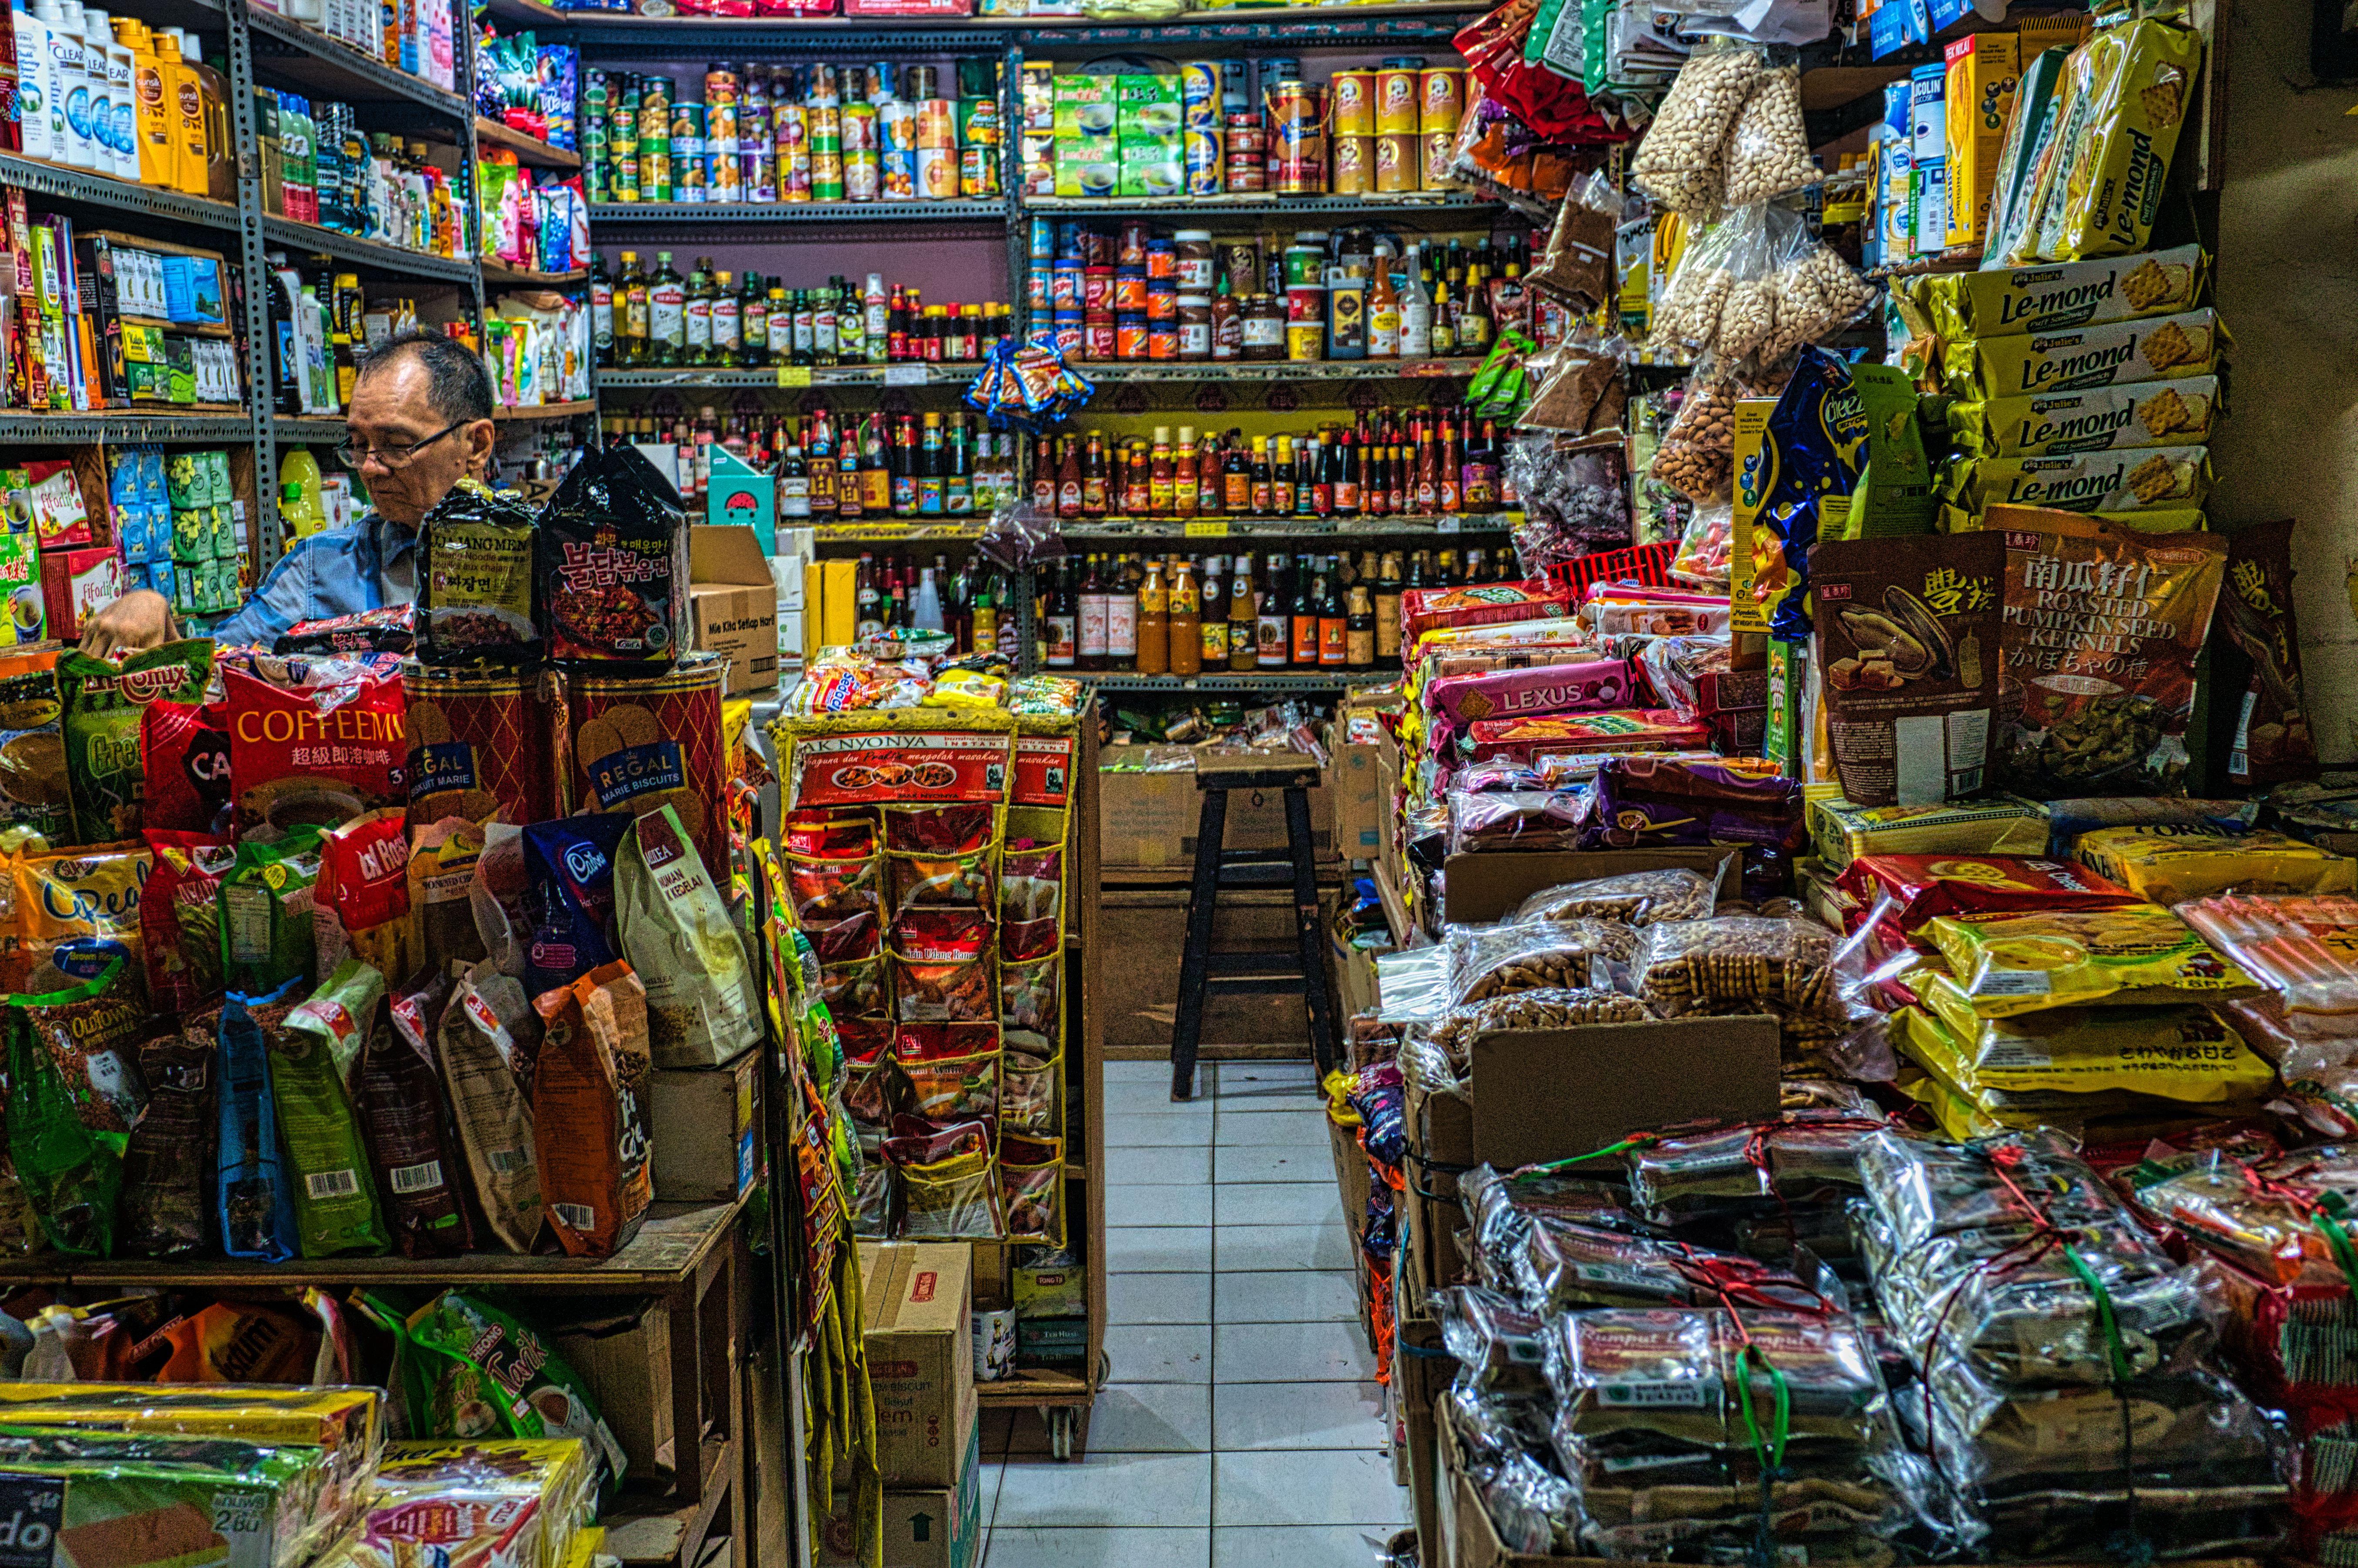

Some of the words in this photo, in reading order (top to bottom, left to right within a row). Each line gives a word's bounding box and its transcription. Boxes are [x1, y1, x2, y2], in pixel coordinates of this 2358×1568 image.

[53, 46, 84, 61] CLEAR
[1945, 47, 1956, 60] PEK
[1956, 40, 1970, 55] NILAI
[110, 68, 128, 80] EAR
[137, 78, 161, 87] sunsilk
[179, 92, 198, 101] sunsilk
[2109, 127, 2153, 247] Le-mond
[2100, 179, 2114, 221] Julie's
[2027, 272, 2061, 282] Julie's
[2000, 270, 2117, 325] Le-mond
[2047, 337, 2082, 348] Julie's
[2021, 334, 2137, 391] Le-mond
[2048, 399, 2081, 409] Julie's
[2019, 398, 2135, 449] Le-mond
[2038, 460, 2070, 471] Julie's
[2007, 464, 2126, 505] Le-mond
[465, 551, 497, 561] Noodle
[559, 542, 669, 591] 불닭볶음면
[447, 574, 491, 592] 짜장면
[2024, 556, 2171, 601] 南瓜籽仁
[2037, 591, 2150, 618] ROASTED
[709, 622, 722, 635] Mie
[722, 621, 736, 633] Kita
[738, 617, 759, 632] Setiap
[759, 614, 776, 627] Hari!
[2002, 605, 2120, 635] PUMPKIN
[2120, 616, 2177, 641] SEED
[2029, 627, 2144, 656] KERNELS
[2010, 646, 2148, 681] かぼちゃの種
[1504, 685, 1582, 711] LEXUS
[805, 738, 835, 752] AK
[840, 736, 929, 752] NYONYA
[88, 734, 142, 779] Gree
[191, 751, 231, 781] CA
[292, 747, 391, 766] 超級即溶咖啡
[408, 754, 463, 778] REGAL
[843, 755, 859, 763] dan
[907, 751, 954, 762] mengolah
[957, 752, 1000, 762] masakan
[1018, 756, 1060, 764] masakan
[437, 774, 470, 786] MARIE
[600, 755, 672, 788] REGAL
[602, 784, 631, 803] MARIE
[632, 772, 680, 790] BISCUITS
[671, 874, 703, 897] KEDELAI
[925, 947, 952, 961] Udang
[0, 1511, 53, 1551] do
